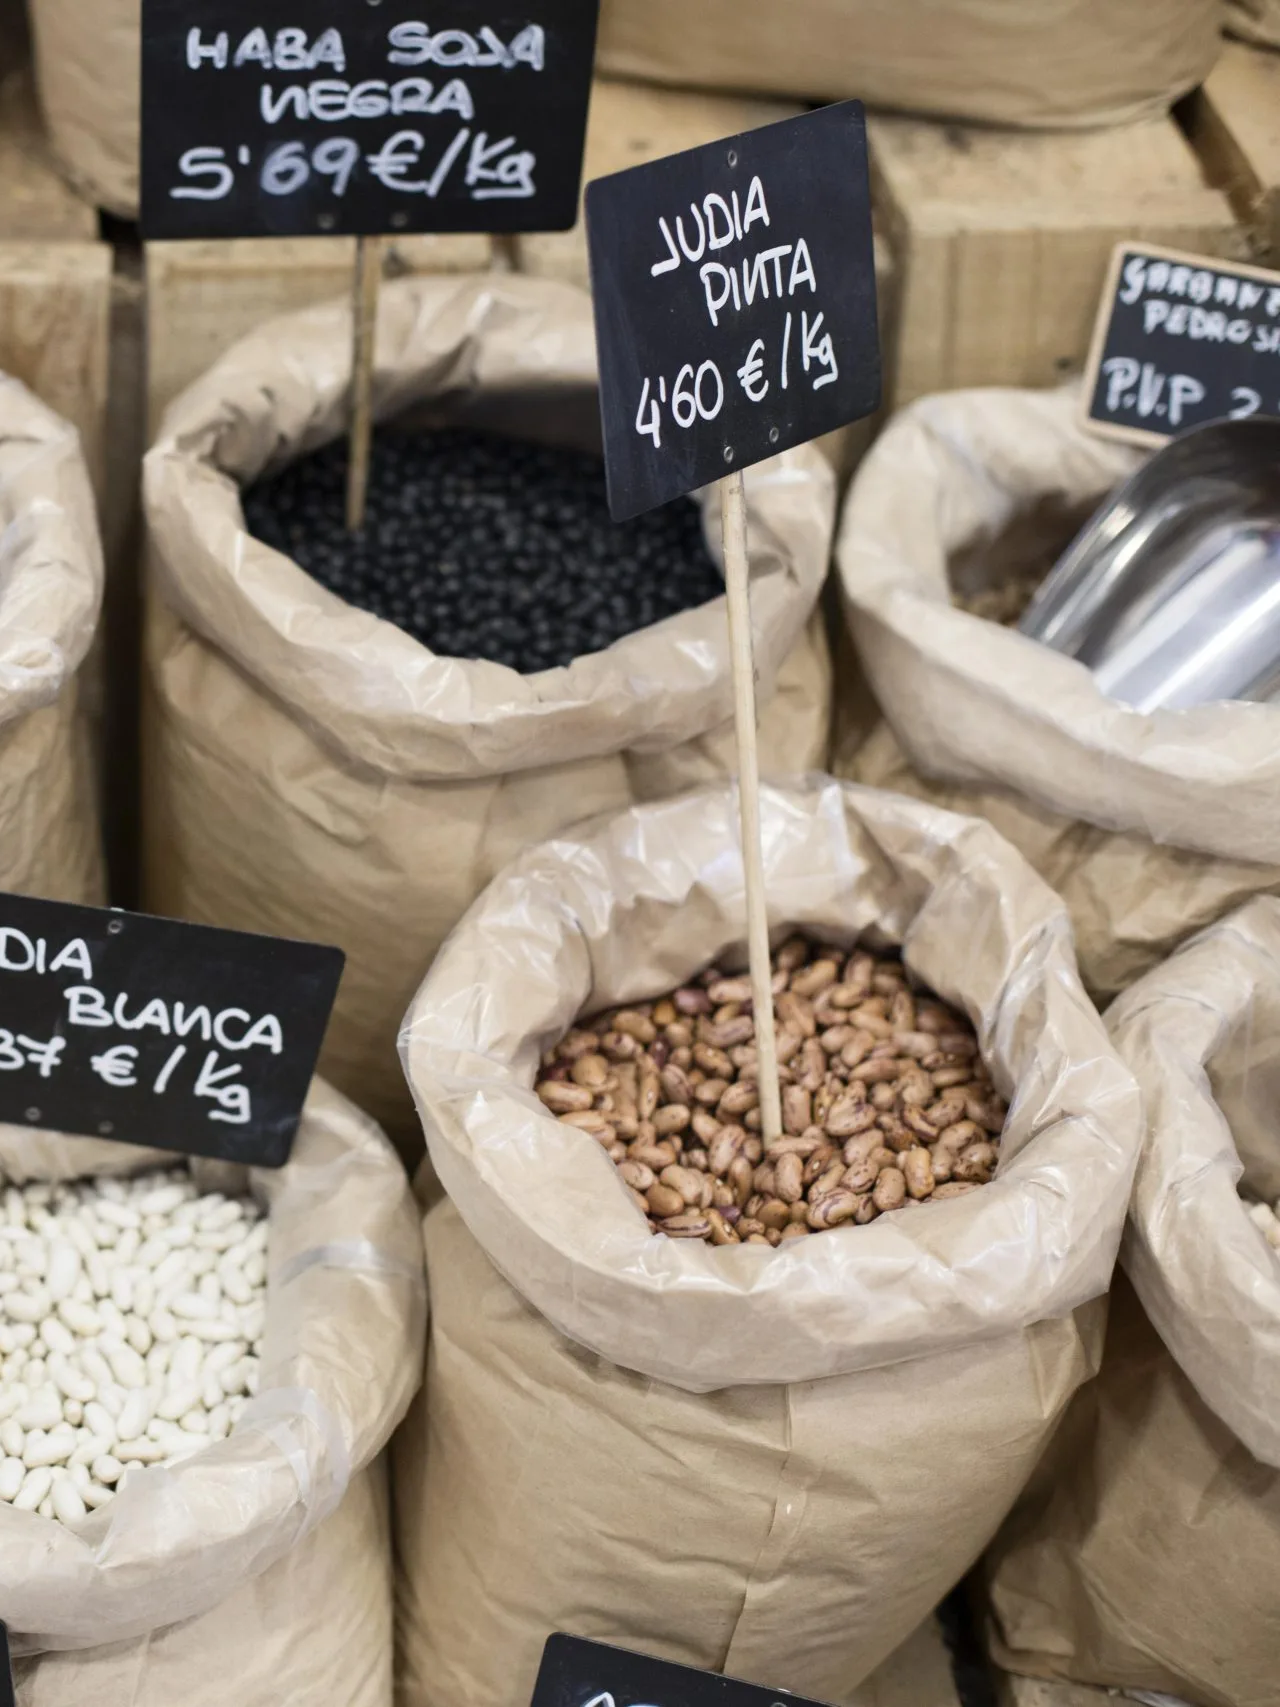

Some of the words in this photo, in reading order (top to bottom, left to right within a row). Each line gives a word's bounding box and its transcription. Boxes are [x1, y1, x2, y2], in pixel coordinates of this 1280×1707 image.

[186, 27, 346, 71] HABA
[388, 21, 544, 71] SOJA
[260, 78, 474, 123] NEGRA
[651, 176, 770, 276] JUDIA
[700, 238, 816, 326] PINTA
[635, 360, 723, 448] 4'60
[1103, 357, 1206, 425] P.V.P
[63, 986, 282, 1054] BLANCA
